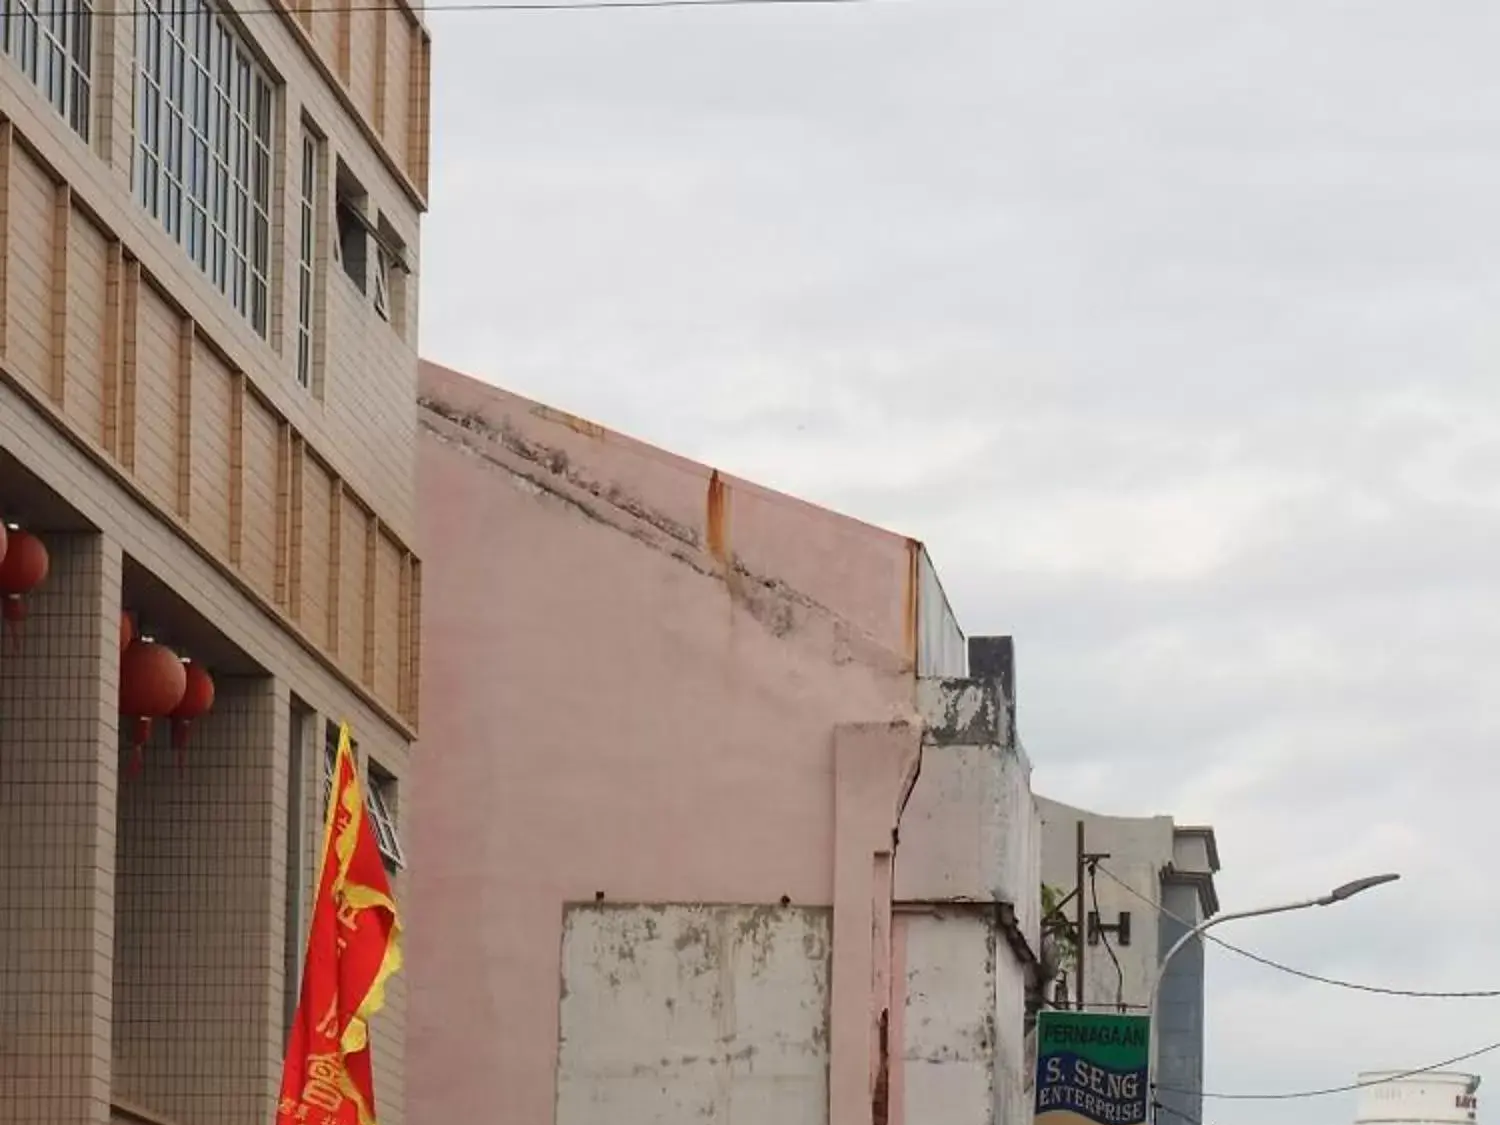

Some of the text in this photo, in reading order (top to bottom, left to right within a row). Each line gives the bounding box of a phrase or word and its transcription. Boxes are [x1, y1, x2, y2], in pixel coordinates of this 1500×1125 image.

[1044, 1024, 1145, 1048] PERNIAGAAN
[1074, 1059, 1139, 1099] SENG
[1040, 1087, 1144, 1121] ENTERPRISE
